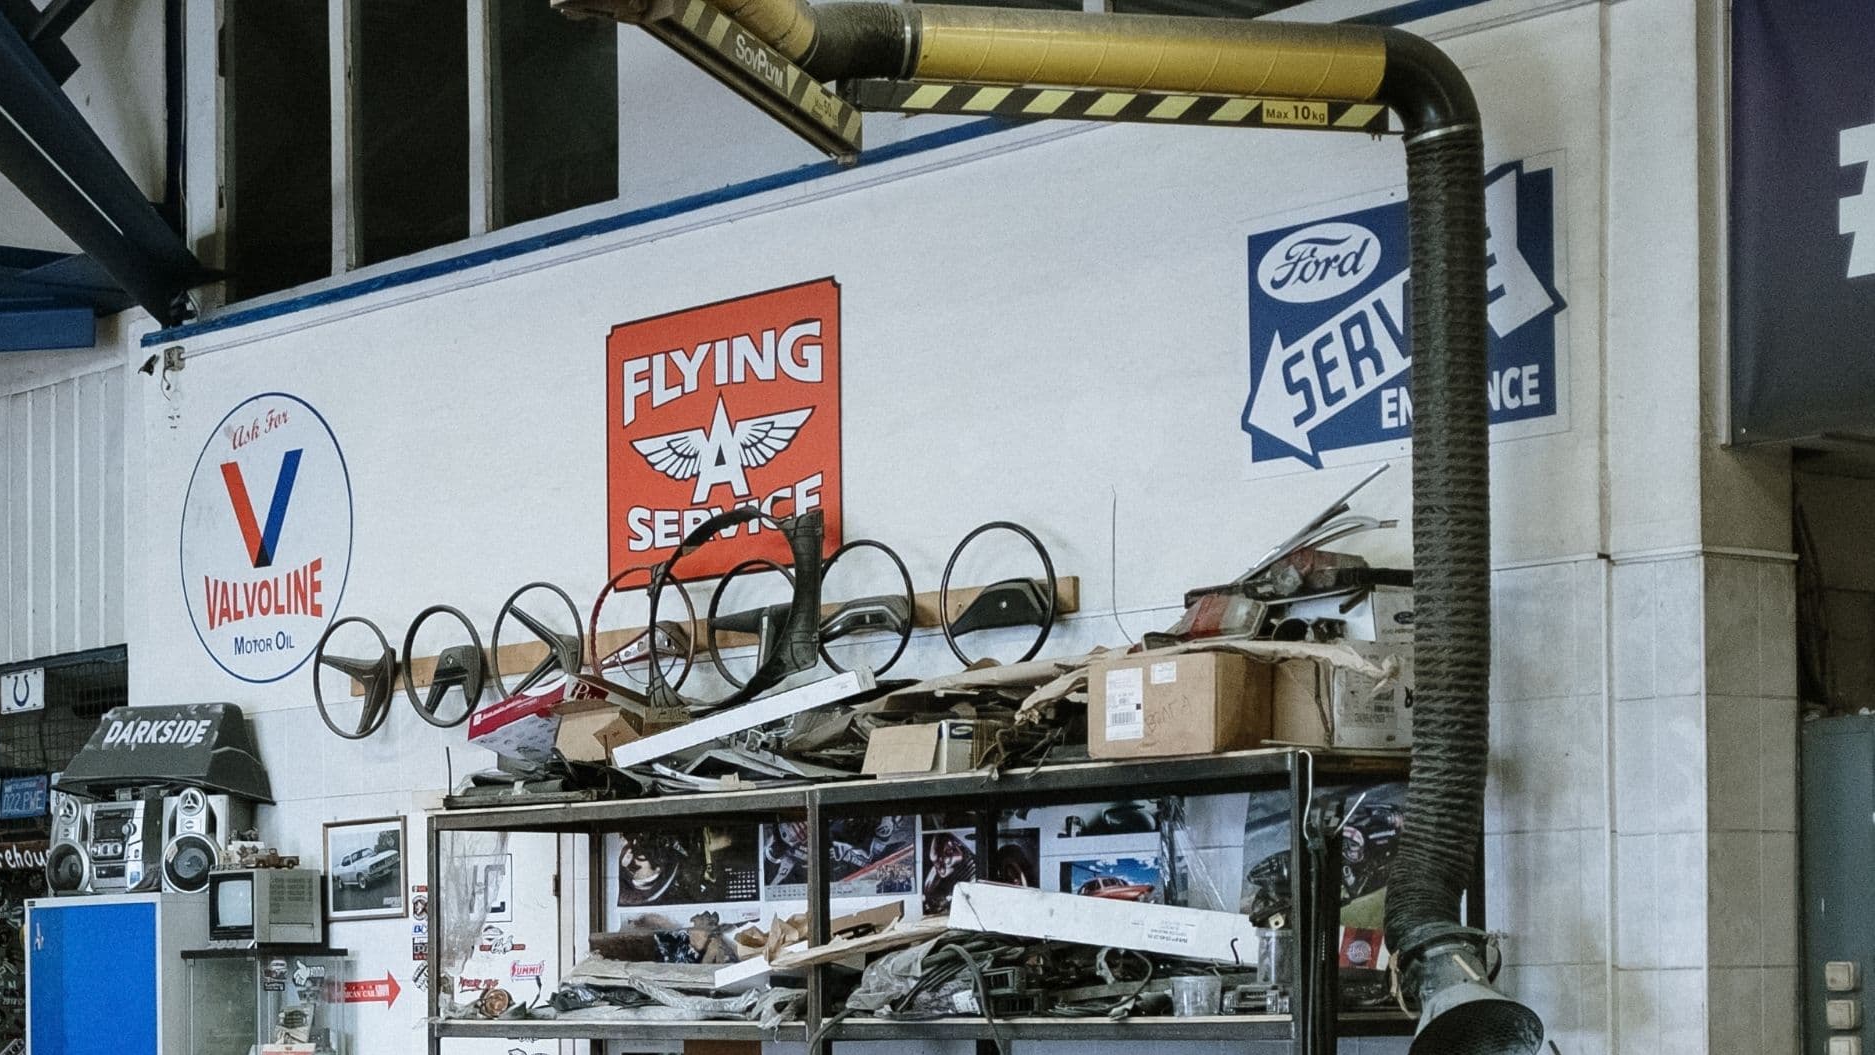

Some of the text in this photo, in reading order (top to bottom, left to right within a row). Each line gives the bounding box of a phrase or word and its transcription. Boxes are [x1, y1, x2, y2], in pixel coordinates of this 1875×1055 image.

[1266, 108, 1289, 119] Max
[1270, 233, 1371, 290] Ford
[622, 318, 824, 429] FLYING
[1381, 364, 1541, 430] ENNCE
[232, 408, 291, 450] Ask For
[203, 556, 323, 631] VALVOLINE
[103, 720, 212, 744] DARKSIDE
